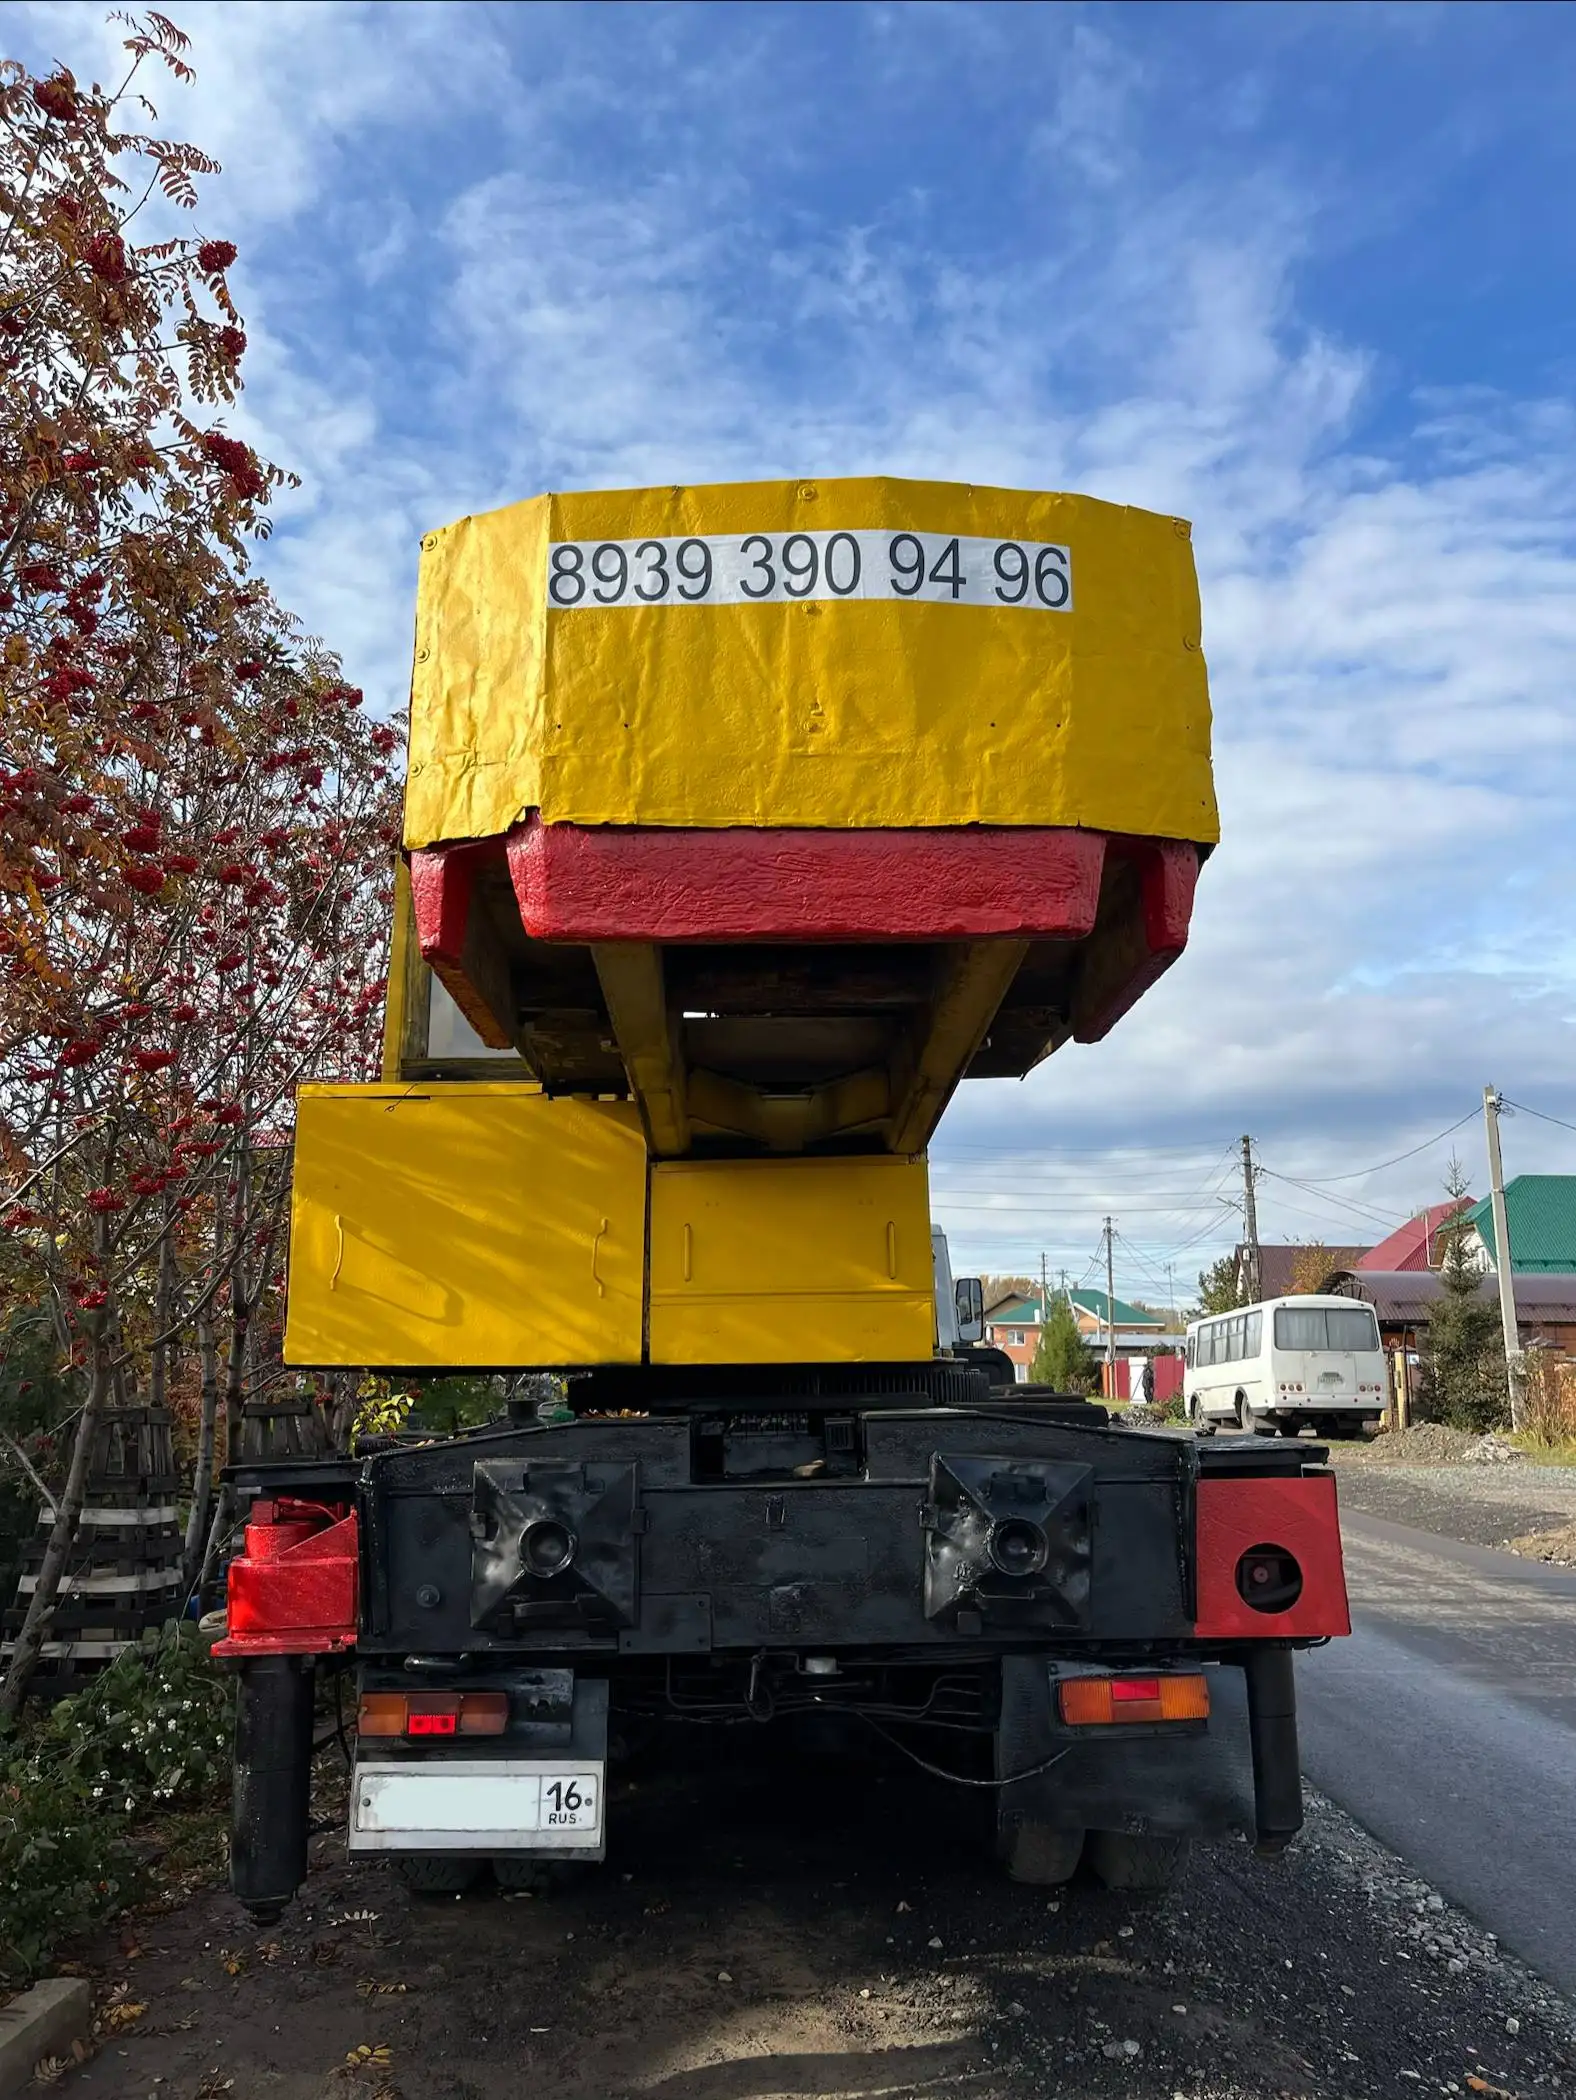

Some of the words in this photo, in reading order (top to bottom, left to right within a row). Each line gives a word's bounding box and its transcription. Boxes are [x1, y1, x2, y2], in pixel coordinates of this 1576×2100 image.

[549, 538, 713, 603] 8939
[739, 532, 861, 597] 390
[889, 533, 967, 599] 94
[993, 543, 1070, 607] 96
[546, 1781, 582, 1811] 16
[548, 1813, 577, 1824] RUS
